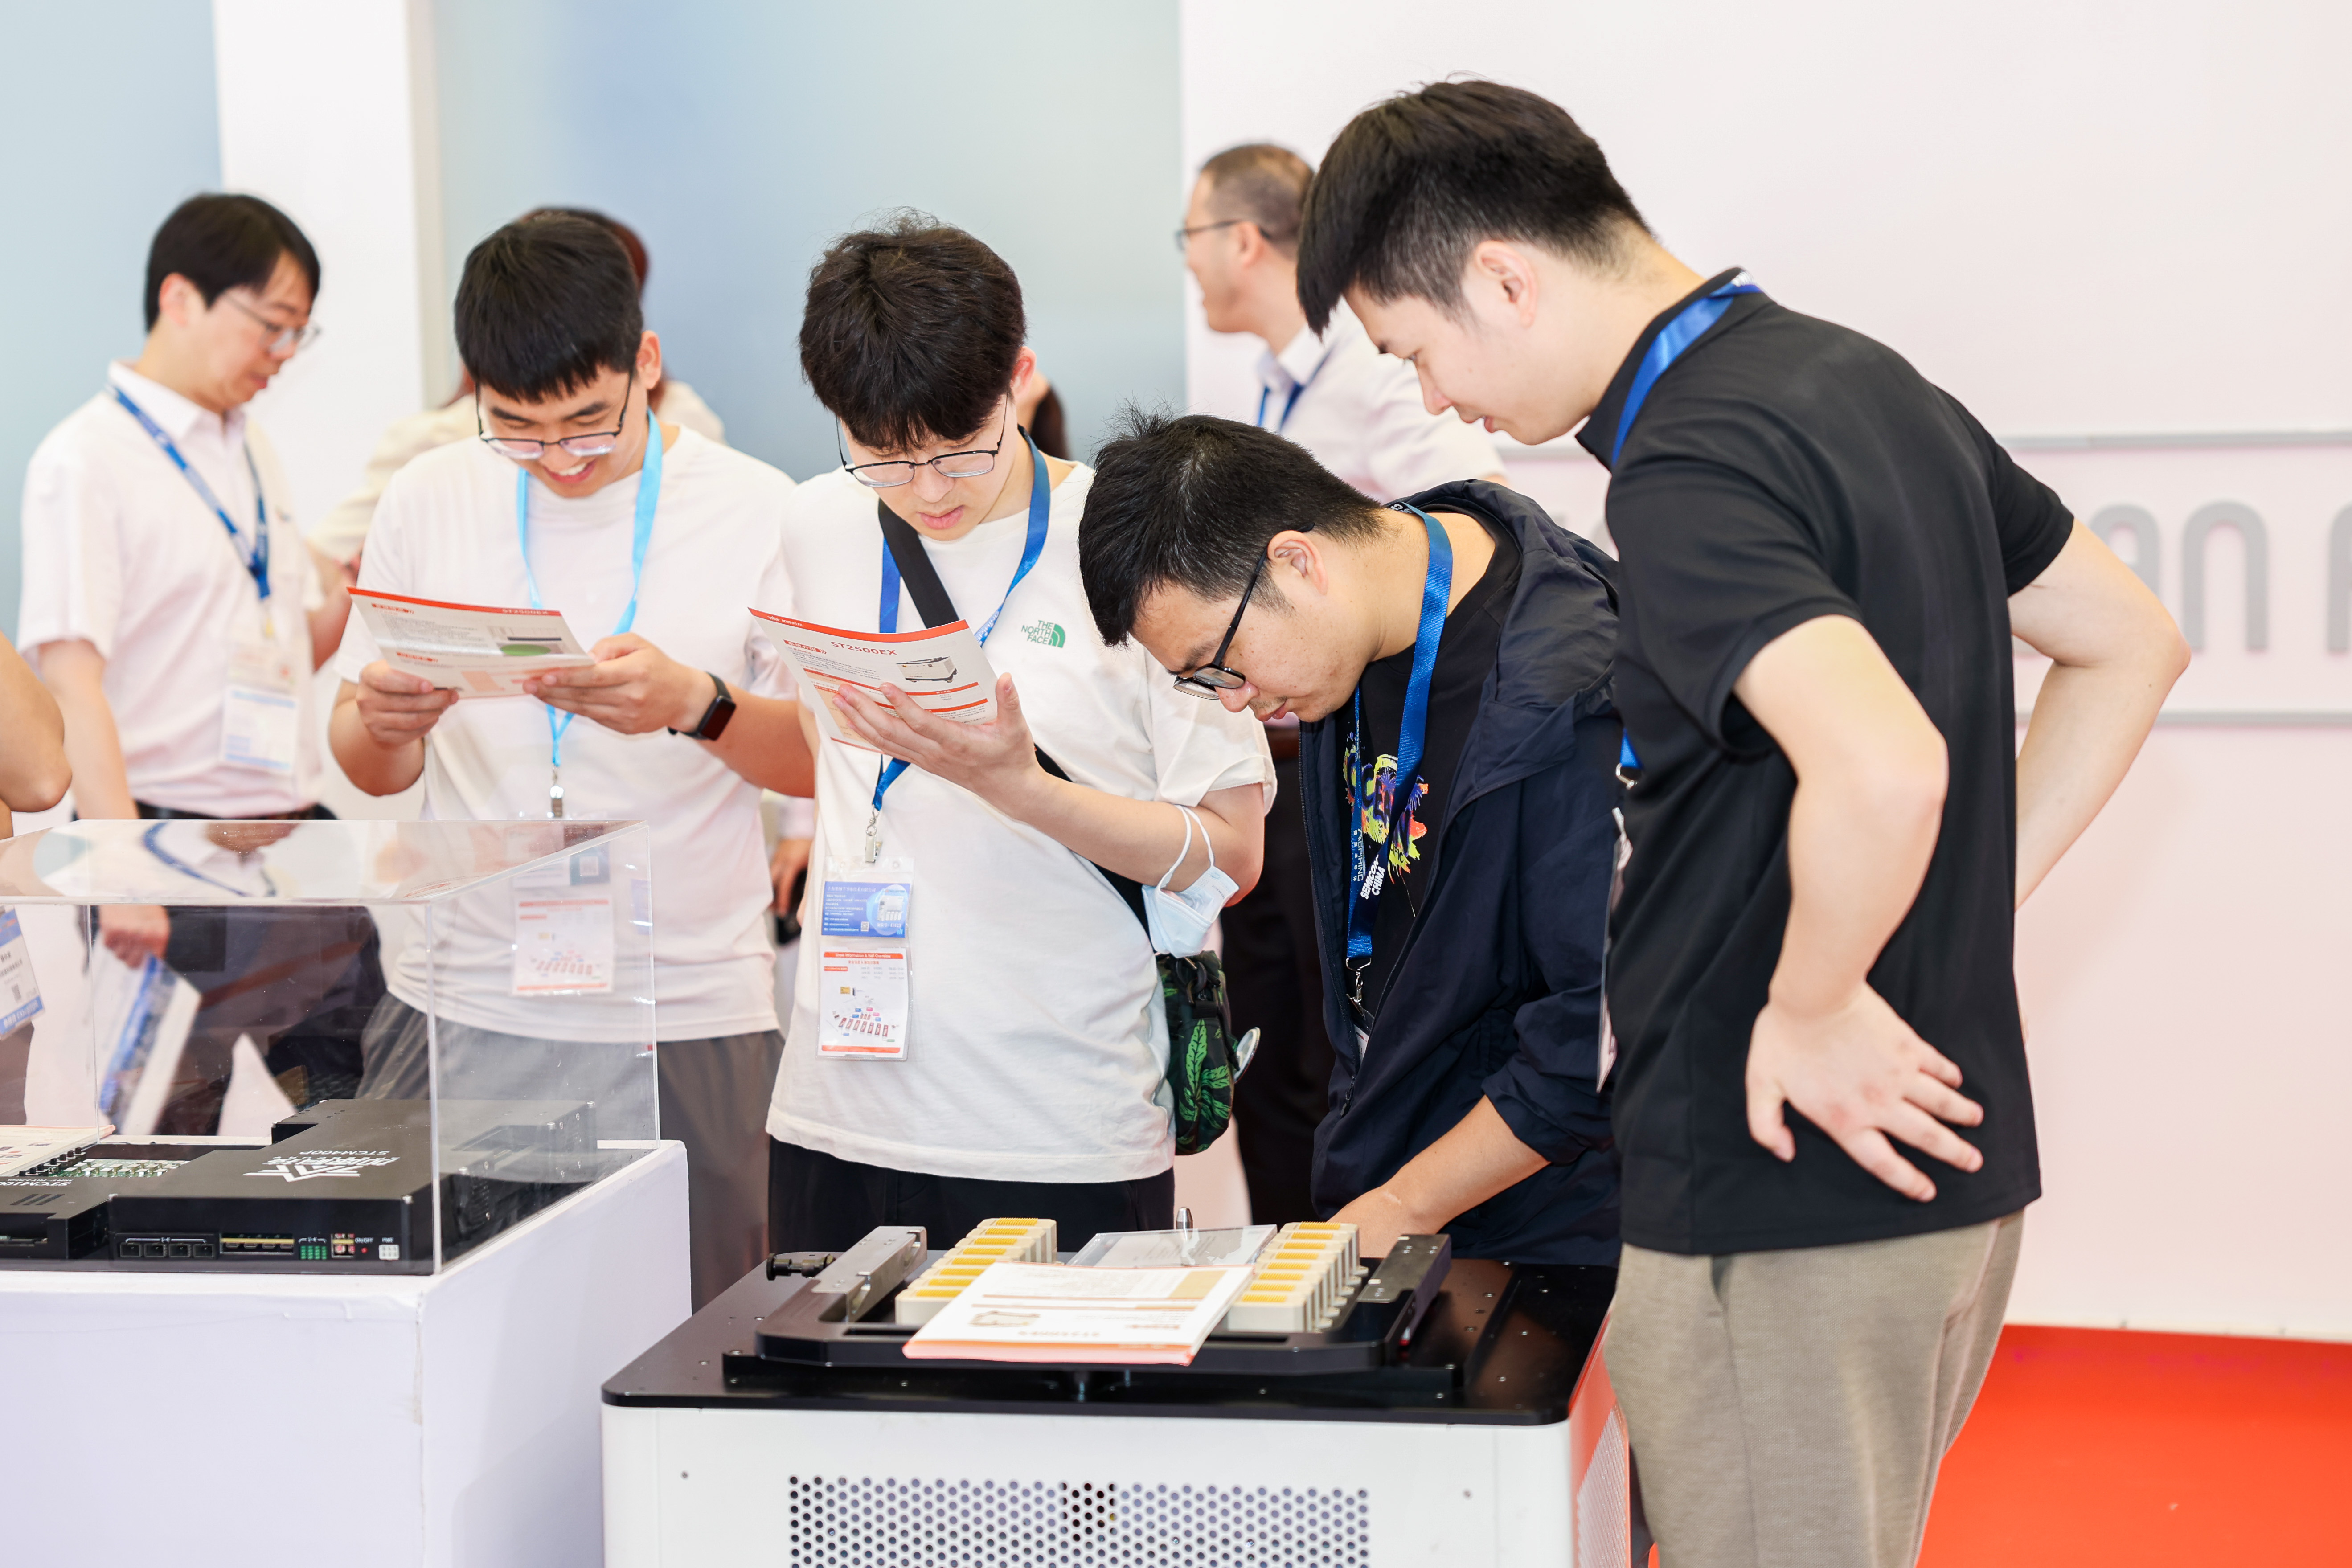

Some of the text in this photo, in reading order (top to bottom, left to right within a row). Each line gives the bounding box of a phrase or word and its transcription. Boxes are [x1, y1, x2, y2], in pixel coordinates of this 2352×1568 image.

[1021, 625, 1051, 638] NORTH
[1038, 620, 1053, 630] THE
[1027, 635, 1049, 645] FACE
[831, 642, 897, 655] ST2500EX
[1357, 828, 1365, 882] ASPIRING
[1371, 866, 1385, 896] CHINA
